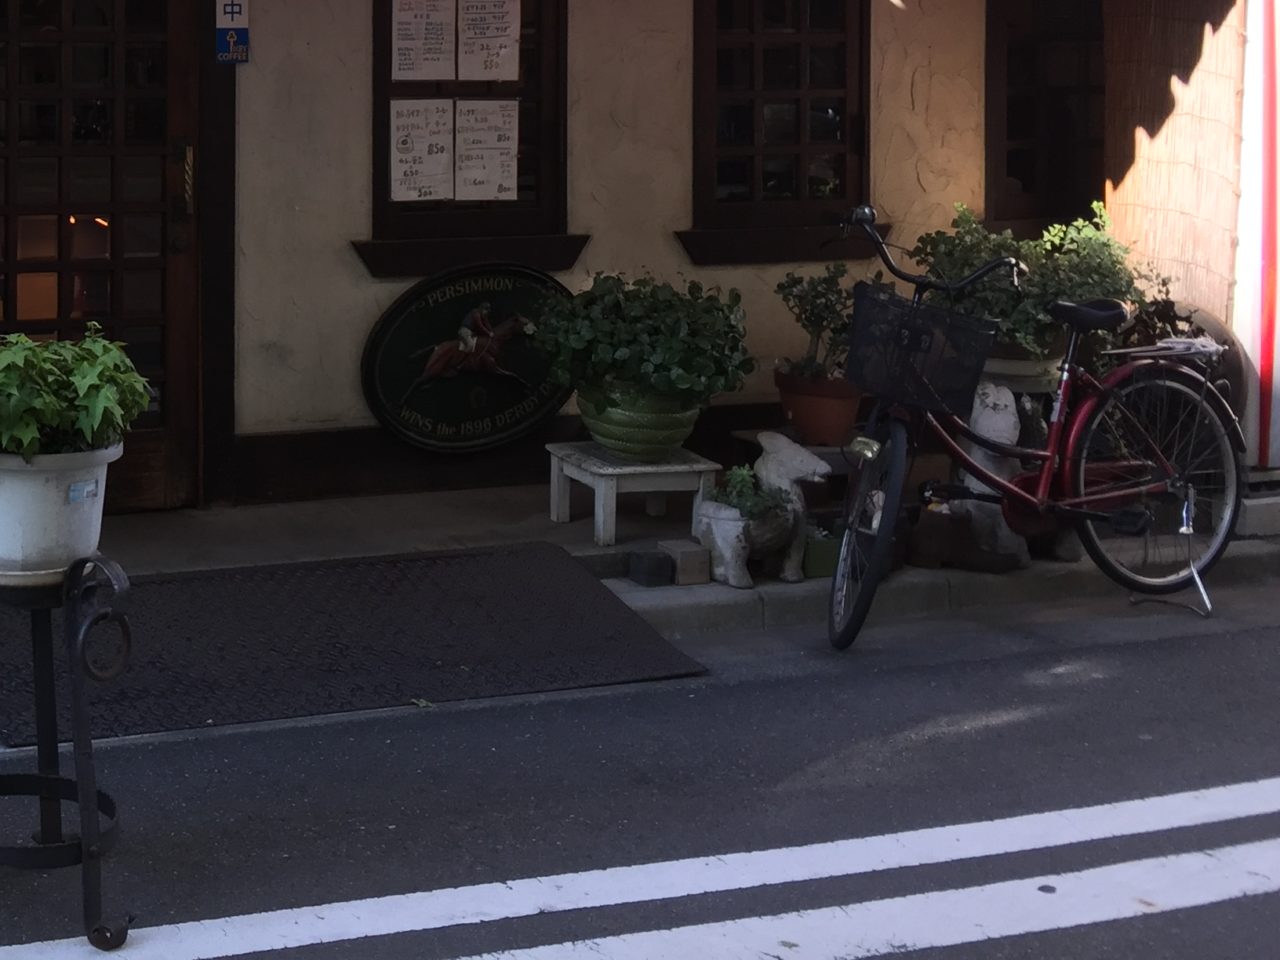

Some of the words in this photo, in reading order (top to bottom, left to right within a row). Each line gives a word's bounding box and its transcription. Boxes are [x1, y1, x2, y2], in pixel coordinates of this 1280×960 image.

[217, 52, 247, 61] COFFEE
[426, 276, 513, 307] PERSIMMON
[399, 405, 433, 433] WINS
[436, 421, 456, 435] the
[460, 416, 493, 435] 1896
[495, 396, 538, 424] DERBY
